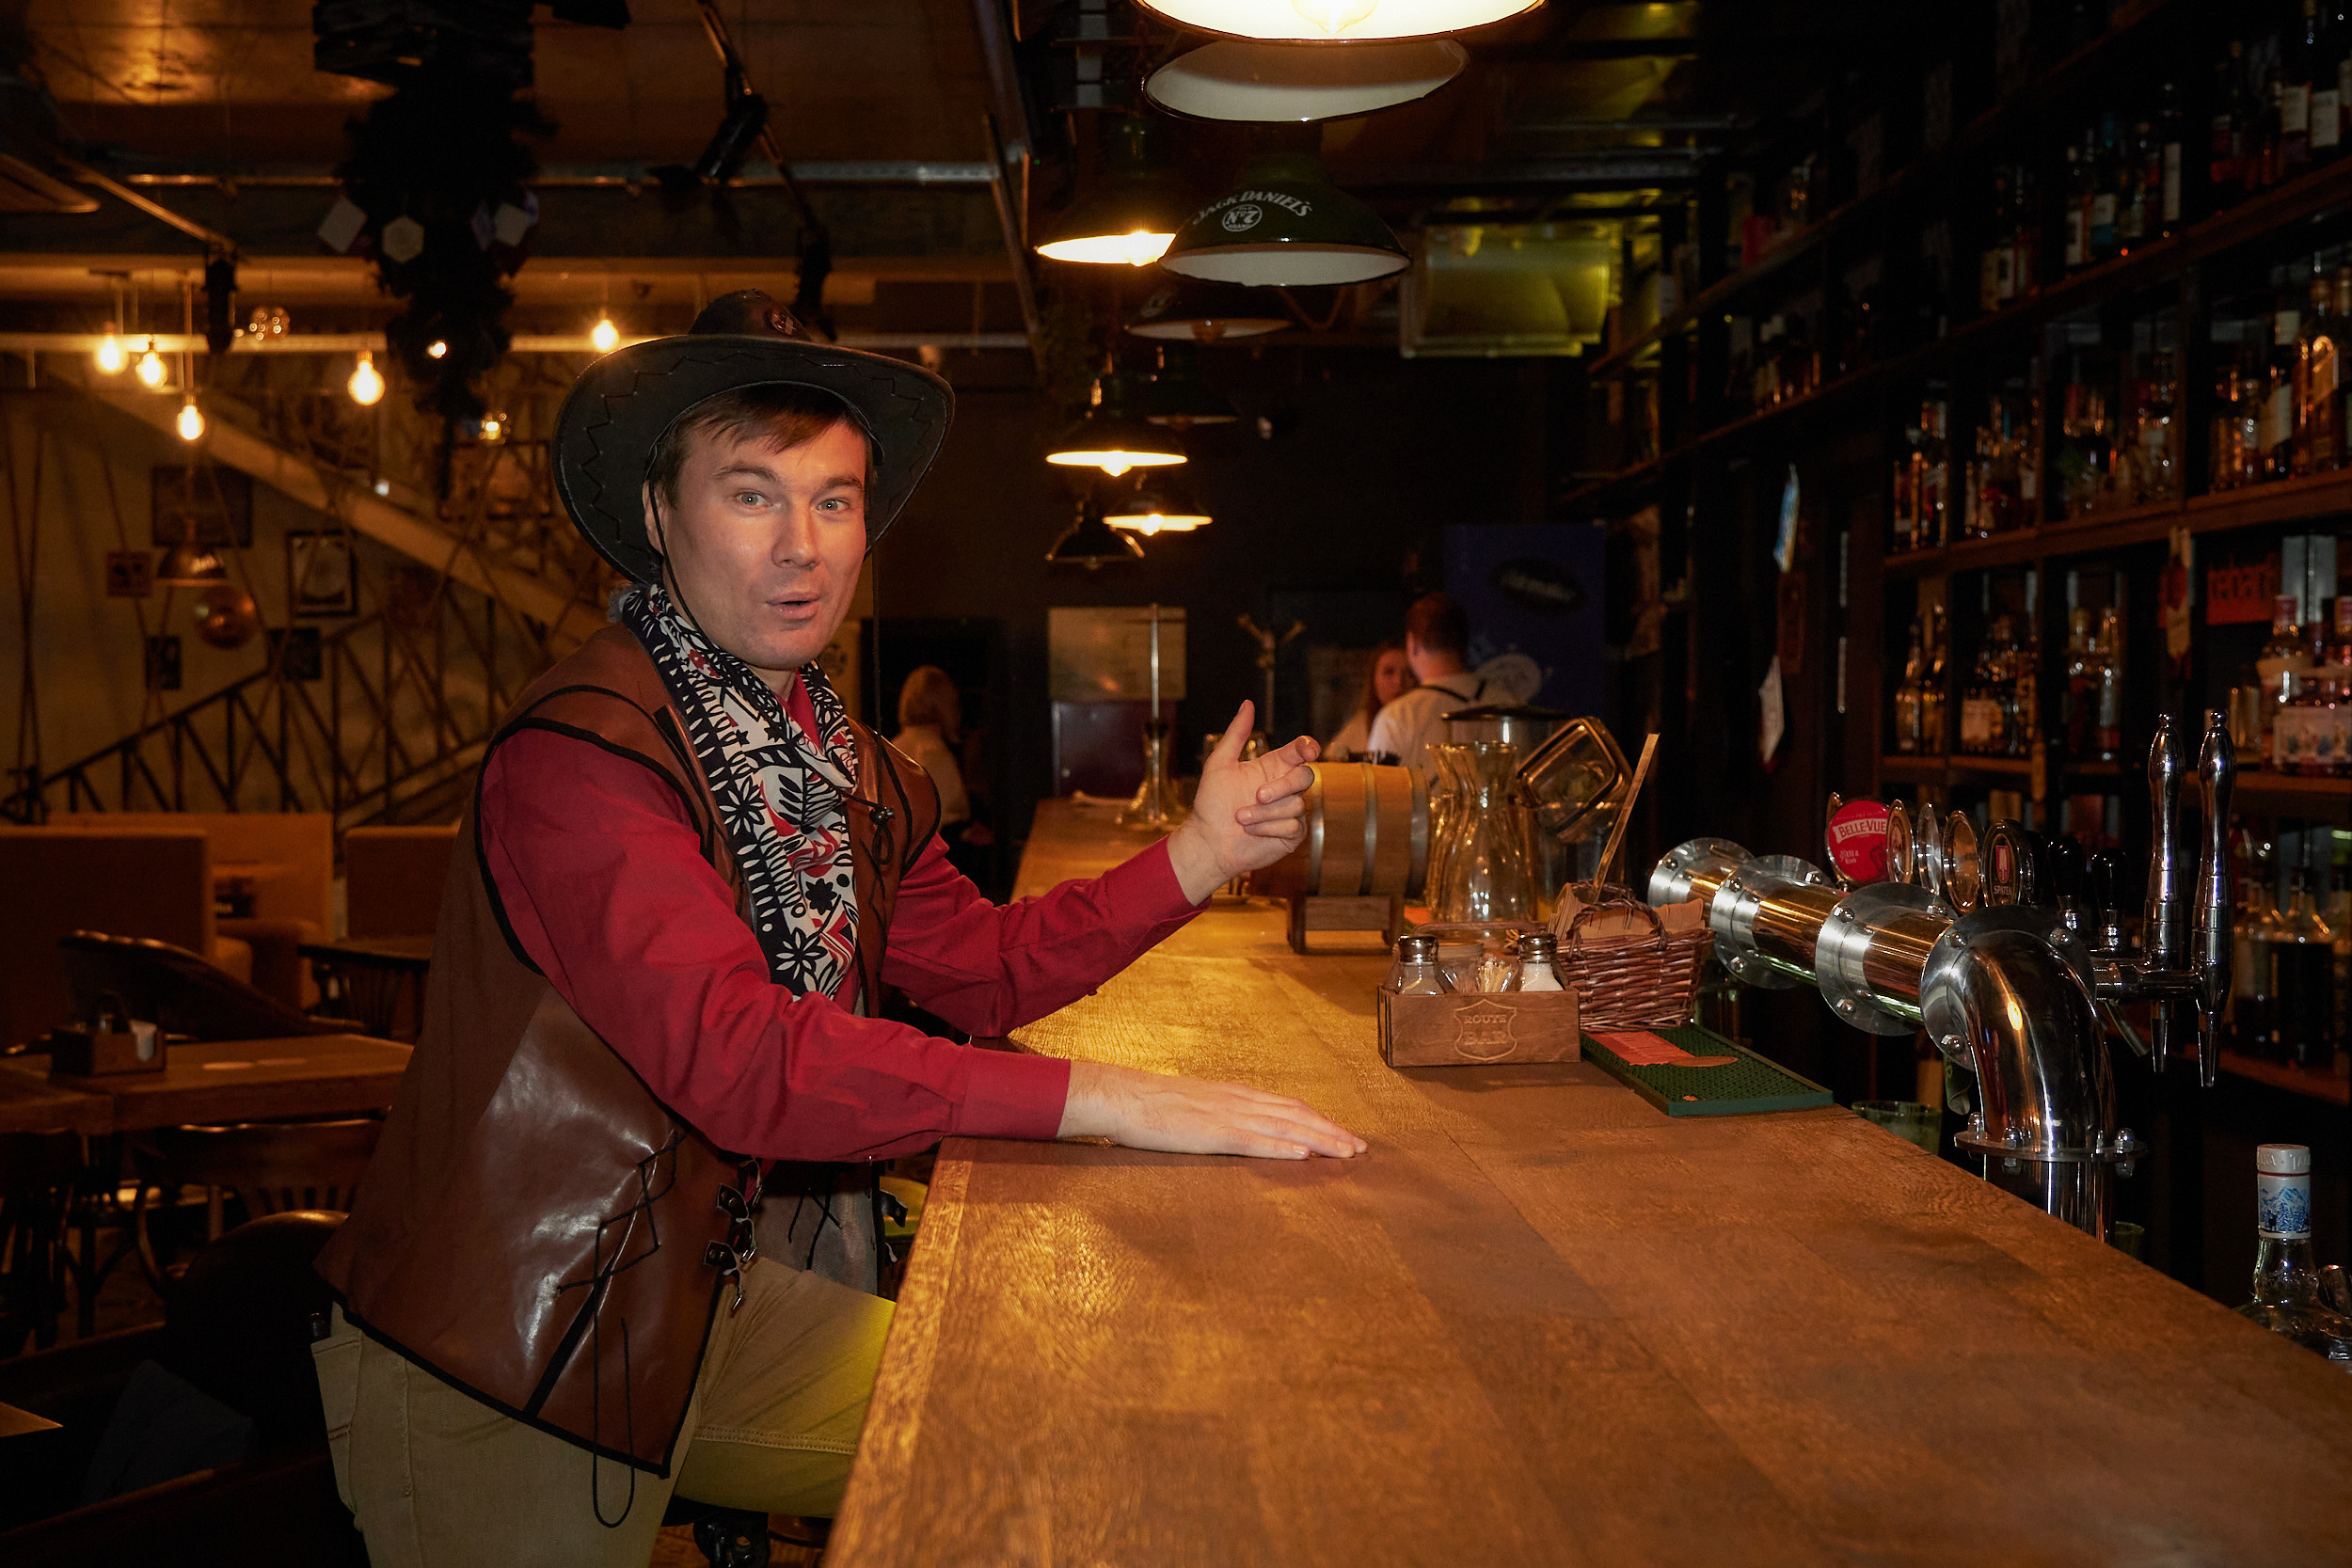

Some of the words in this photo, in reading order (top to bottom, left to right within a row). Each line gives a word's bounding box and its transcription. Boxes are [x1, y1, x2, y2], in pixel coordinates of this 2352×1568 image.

[1239, 190, 1312, 217] DANIEL'S
[1838, 819, 1886, 839] BELLE-VUE
[1463, 1014, 1507, 1024] ROUTE
[1463, 1030, 1507, 1045] BAR
